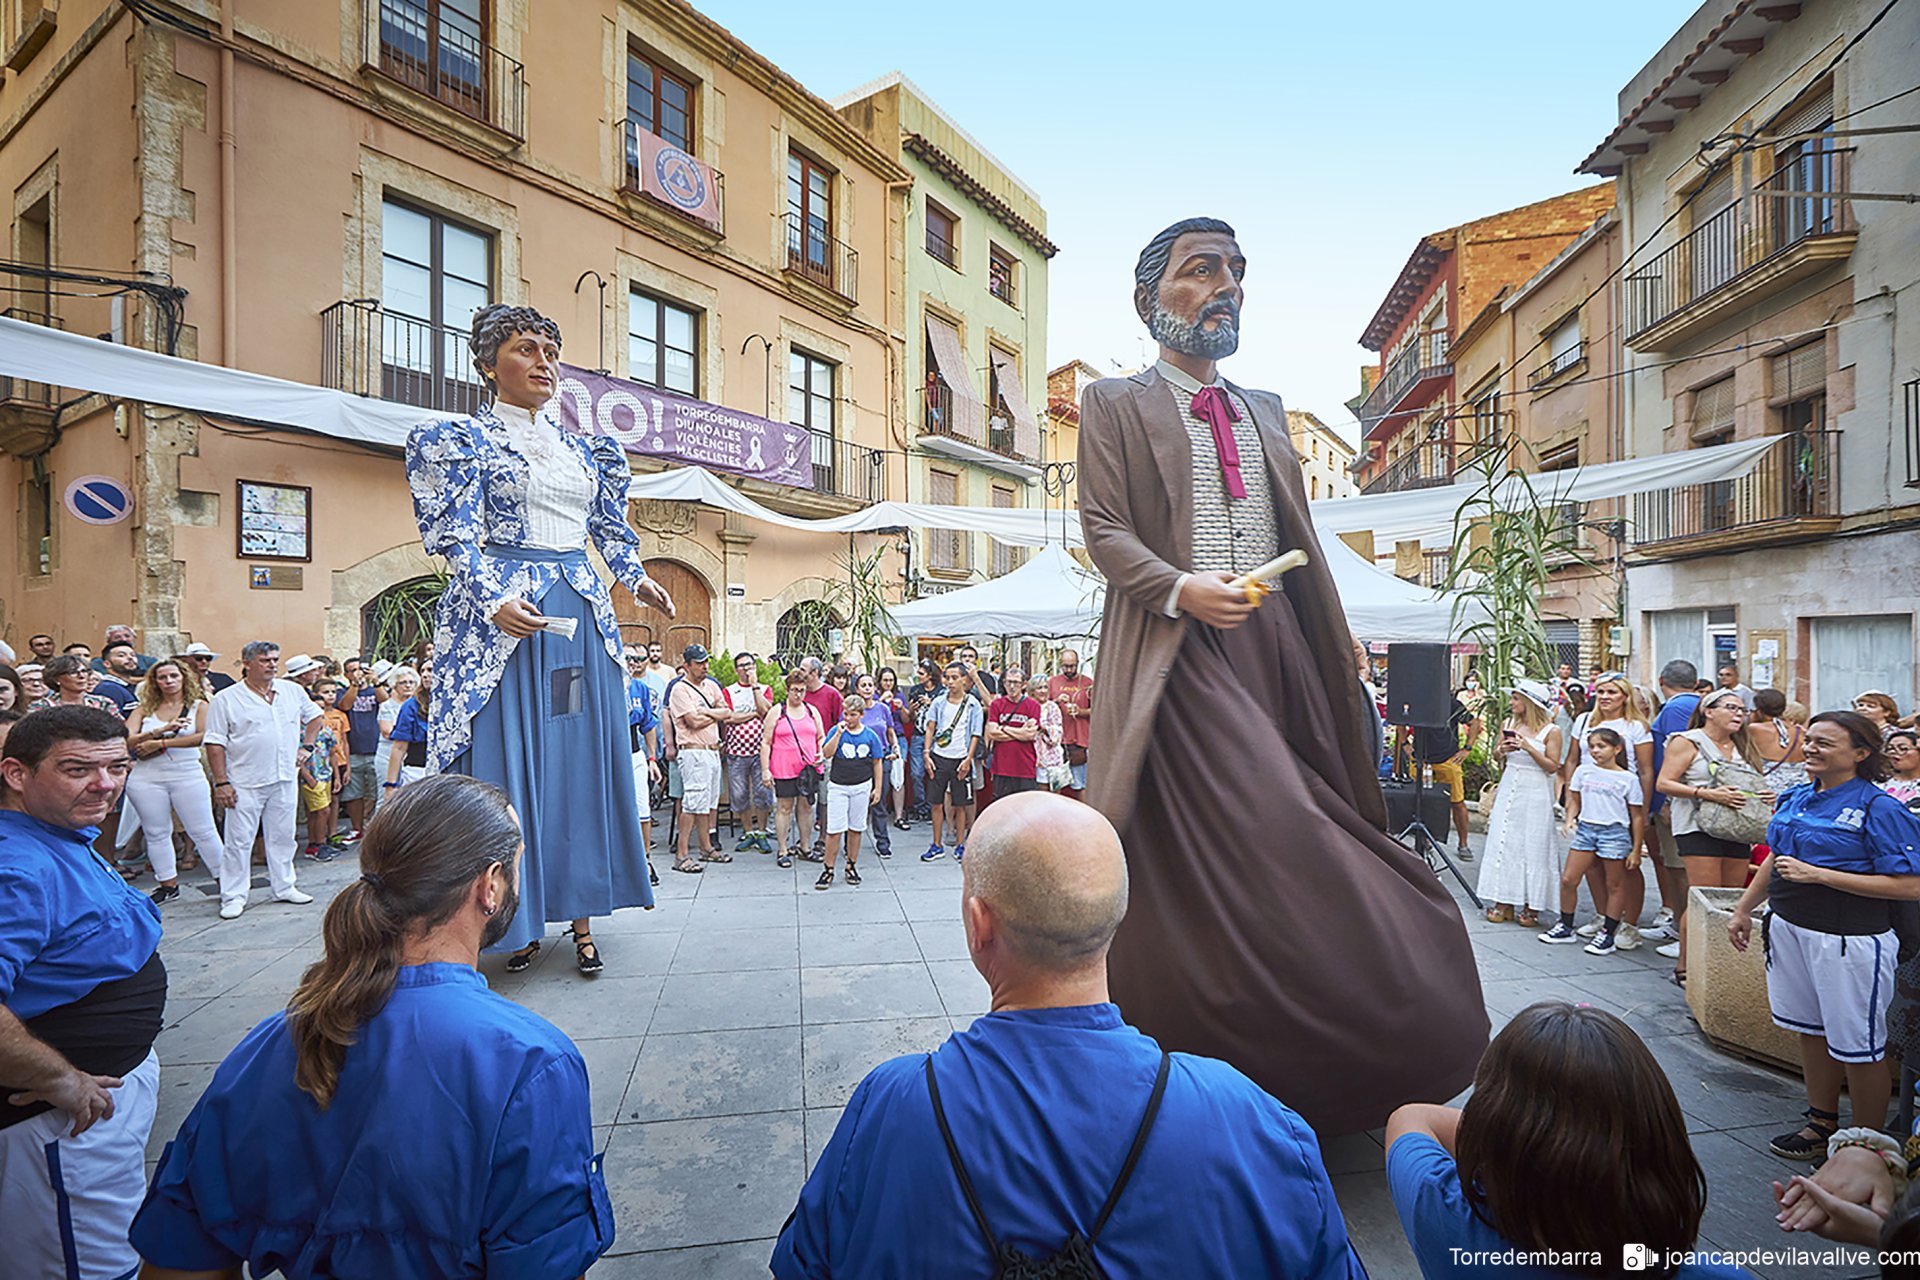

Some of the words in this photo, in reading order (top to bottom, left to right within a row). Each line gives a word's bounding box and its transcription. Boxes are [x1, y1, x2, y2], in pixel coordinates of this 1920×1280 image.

[674, 417, 694, 431] DIU
[695, 422, 713, 435] NO
[722, 429, 742, 442] LES
[676, 431, 742, 455] VIOLÈNCIES
[676, 445, 742, 466] MASCLISTES
